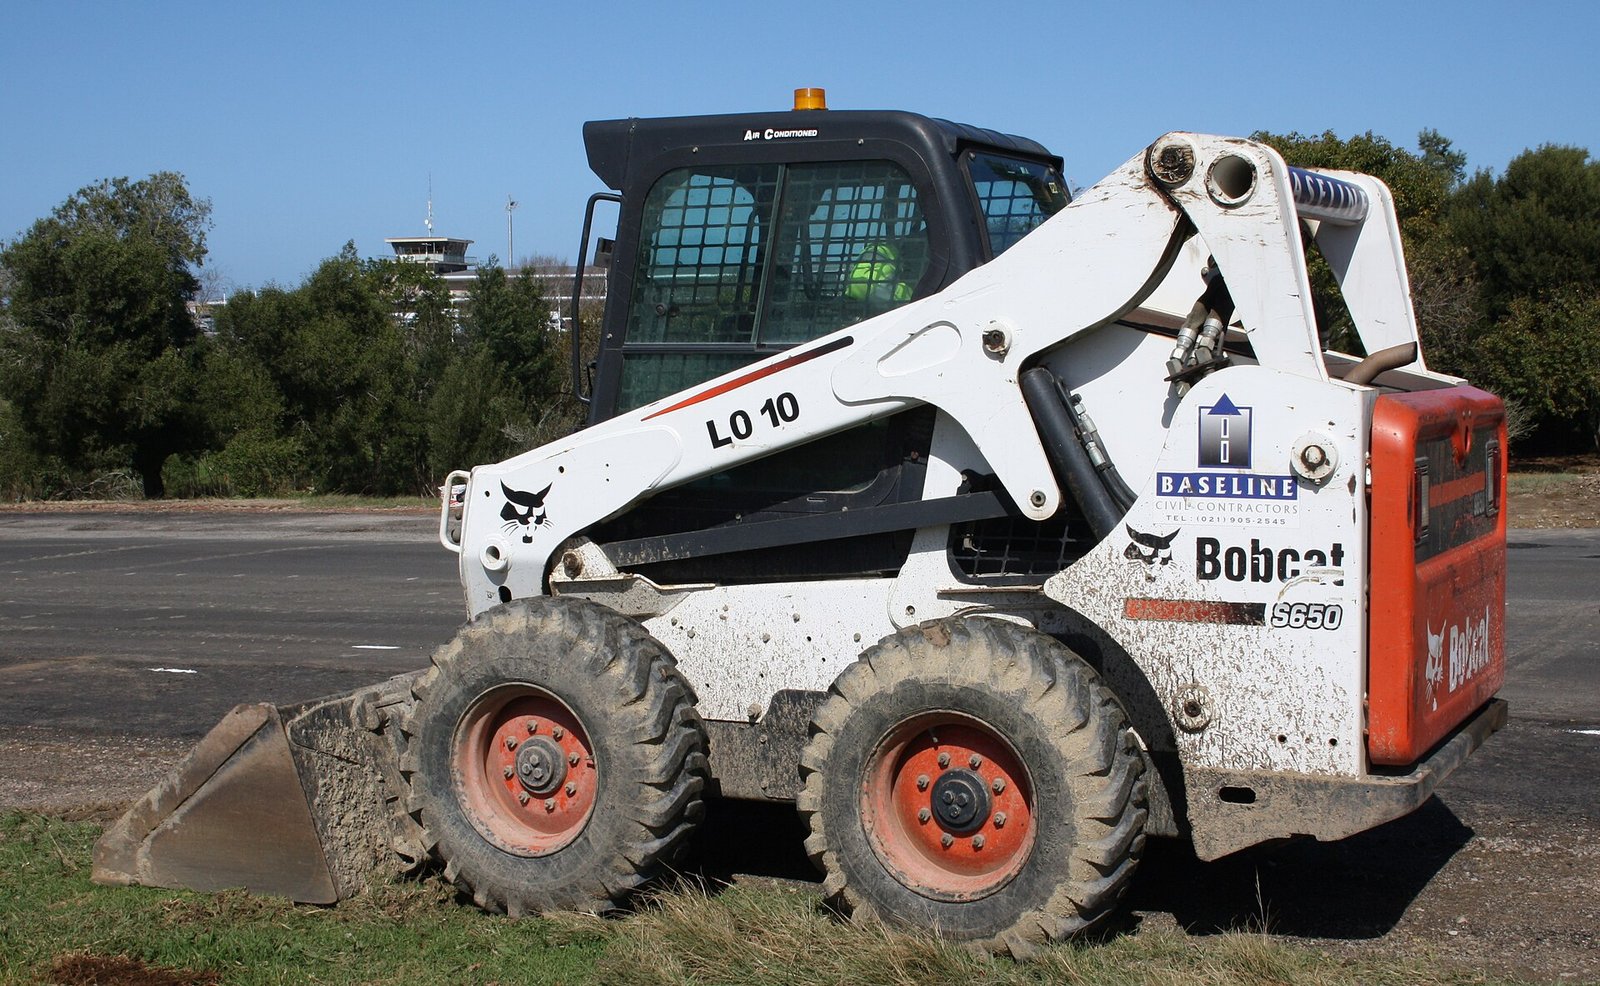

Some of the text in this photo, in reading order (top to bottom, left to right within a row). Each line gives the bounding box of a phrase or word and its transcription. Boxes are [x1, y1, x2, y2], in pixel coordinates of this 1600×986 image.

[743, 128, 818, 141] AIR CONDITIONED
[1292, 172, 1368, 214] ASELINE
[760, 392, 800, 428] 10
[1161, 475, 1294, 497] BASELINE
[1155, 500, 1298, 514] CIVIL CONTRACTORS
[1196, 536, 1344, 587] Bobcat
[1271, 602, 1343, 630] S650
